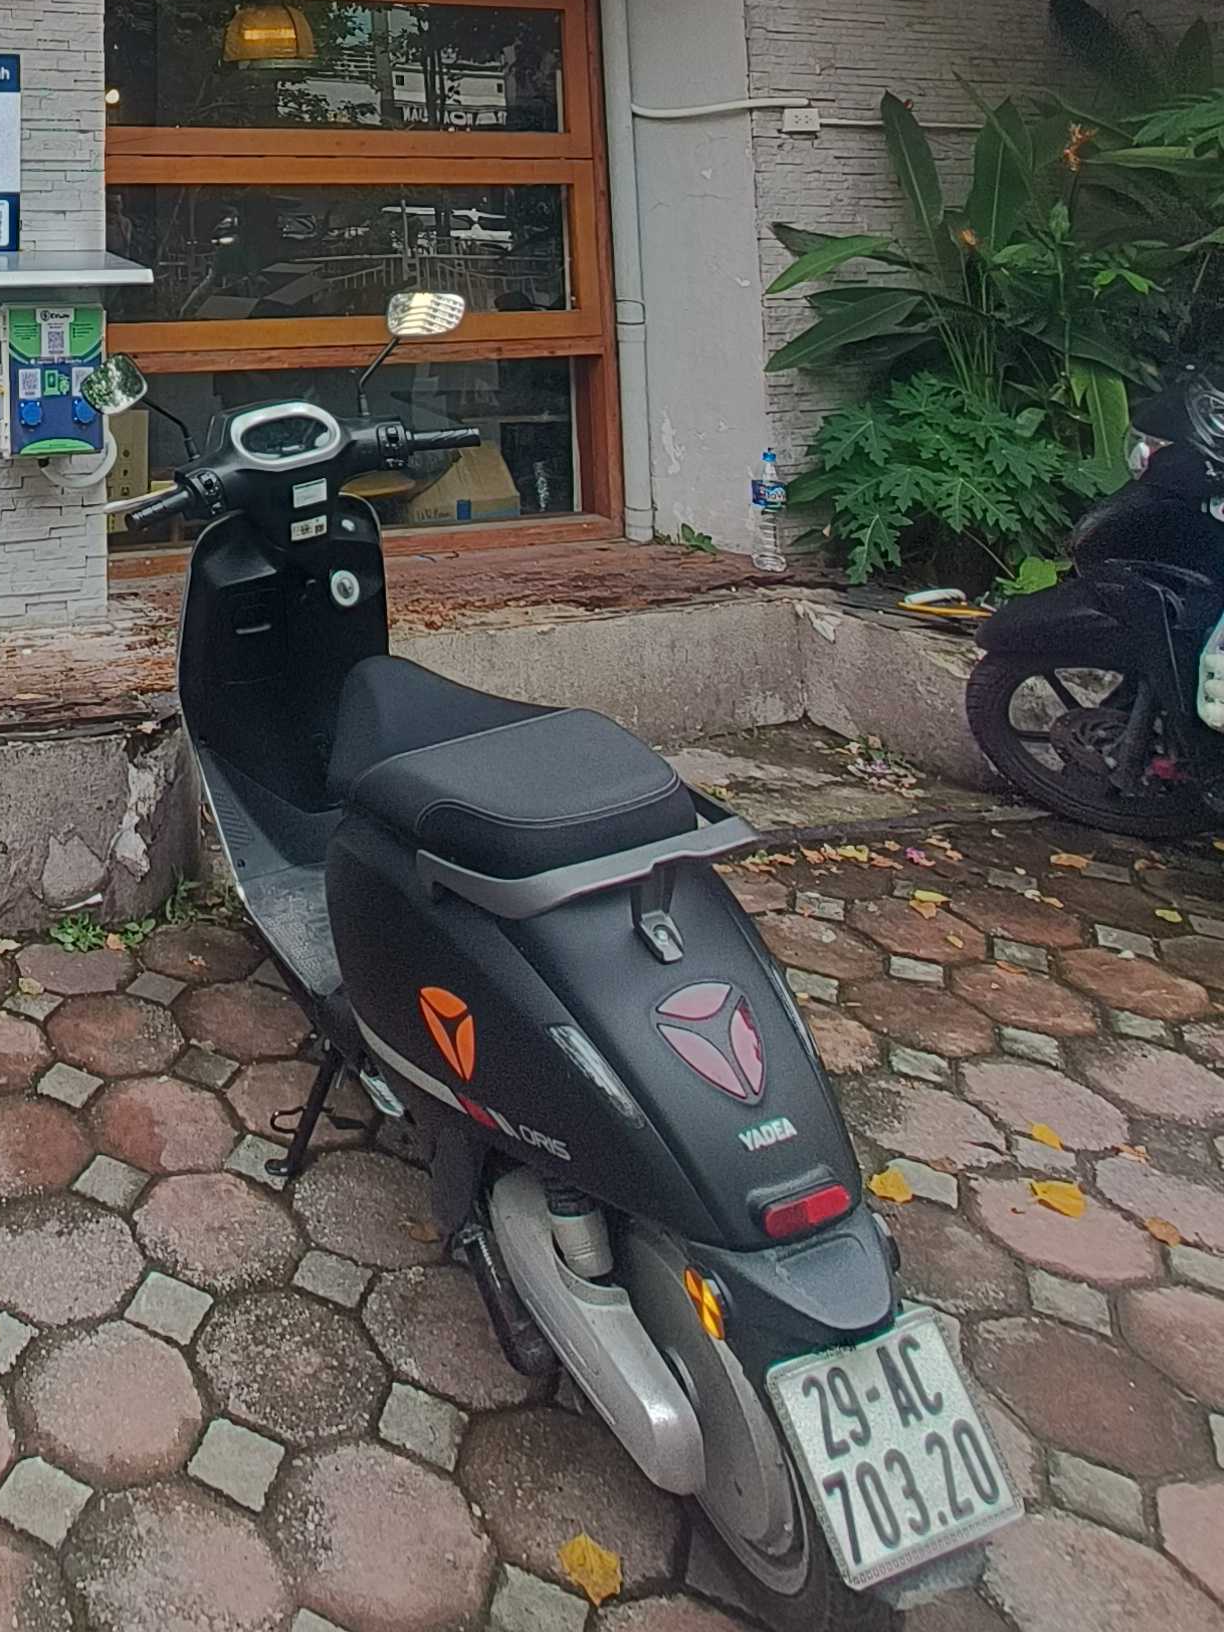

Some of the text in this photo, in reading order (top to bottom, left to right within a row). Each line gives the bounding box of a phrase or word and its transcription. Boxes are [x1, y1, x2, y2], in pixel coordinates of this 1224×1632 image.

[519, 1124, 571, 1161] ORIS
[738, 1117, 798, 1151] YADEA
[802, 1333, 944, 1461] 29-AC
[822, 1419, 1000, 1566] 703.20
